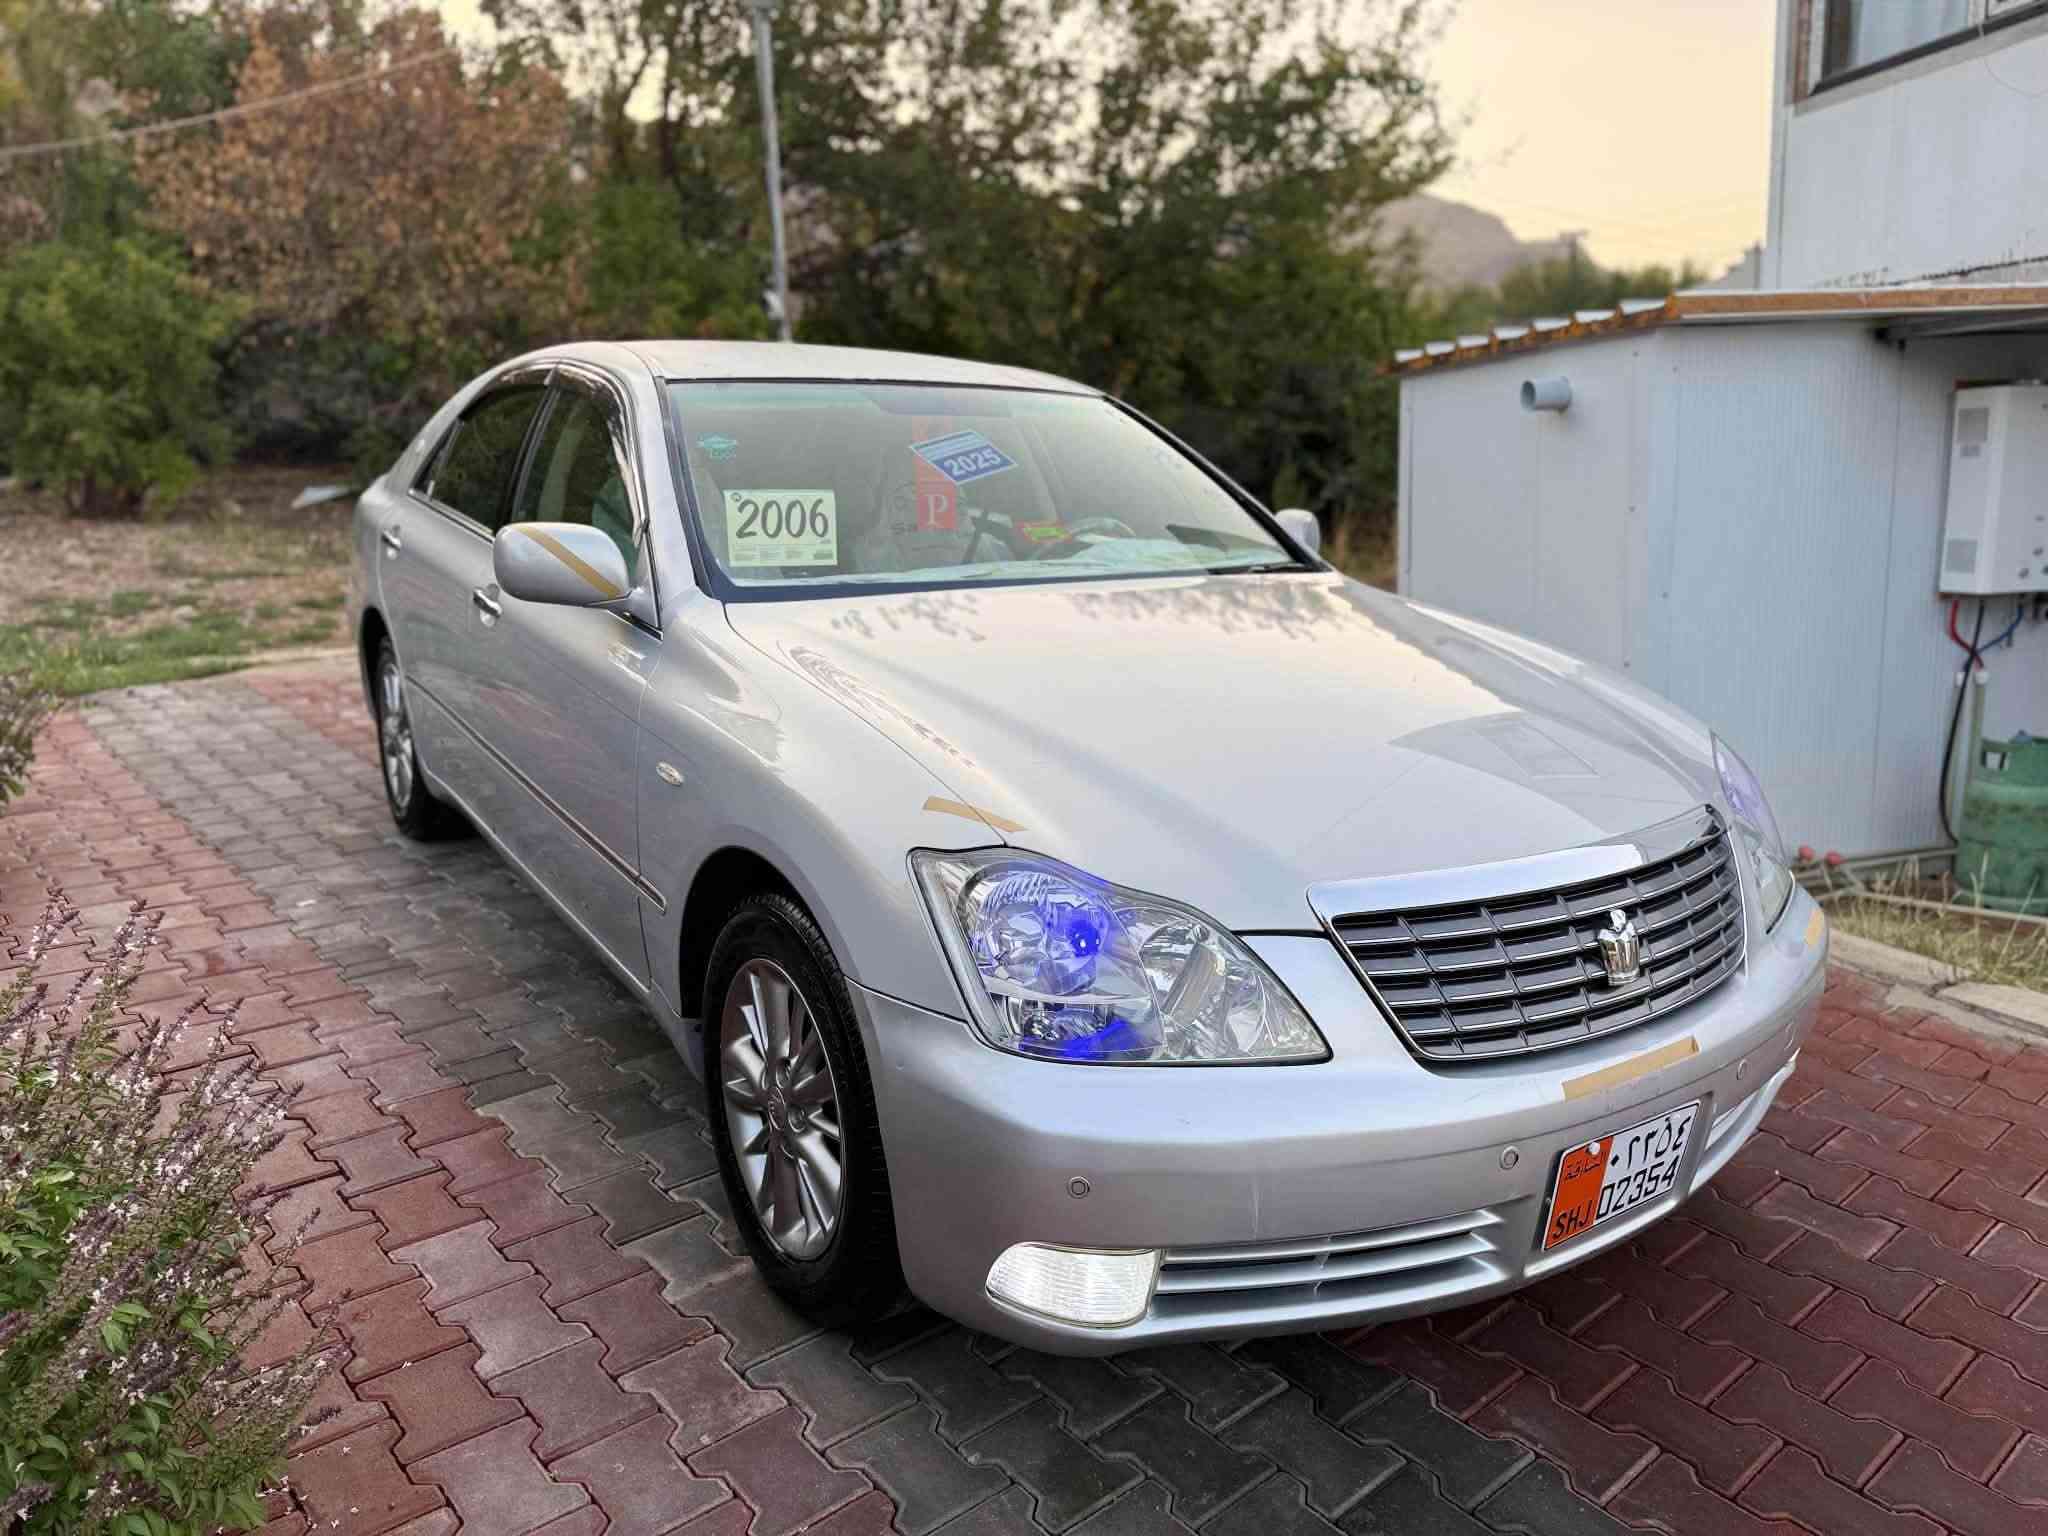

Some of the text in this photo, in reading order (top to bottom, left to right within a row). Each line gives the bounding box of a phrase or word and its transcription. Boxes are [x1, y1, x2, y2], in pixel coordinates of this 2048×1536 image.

[943, 447, 1001, 477] 2025
[735, 497, 829, 539] 2006
[924, 495, 948, 528] P
[1596, 1154, 1680, 1220] 02354
[1552, 1200, 1593, 1239] SHJ
